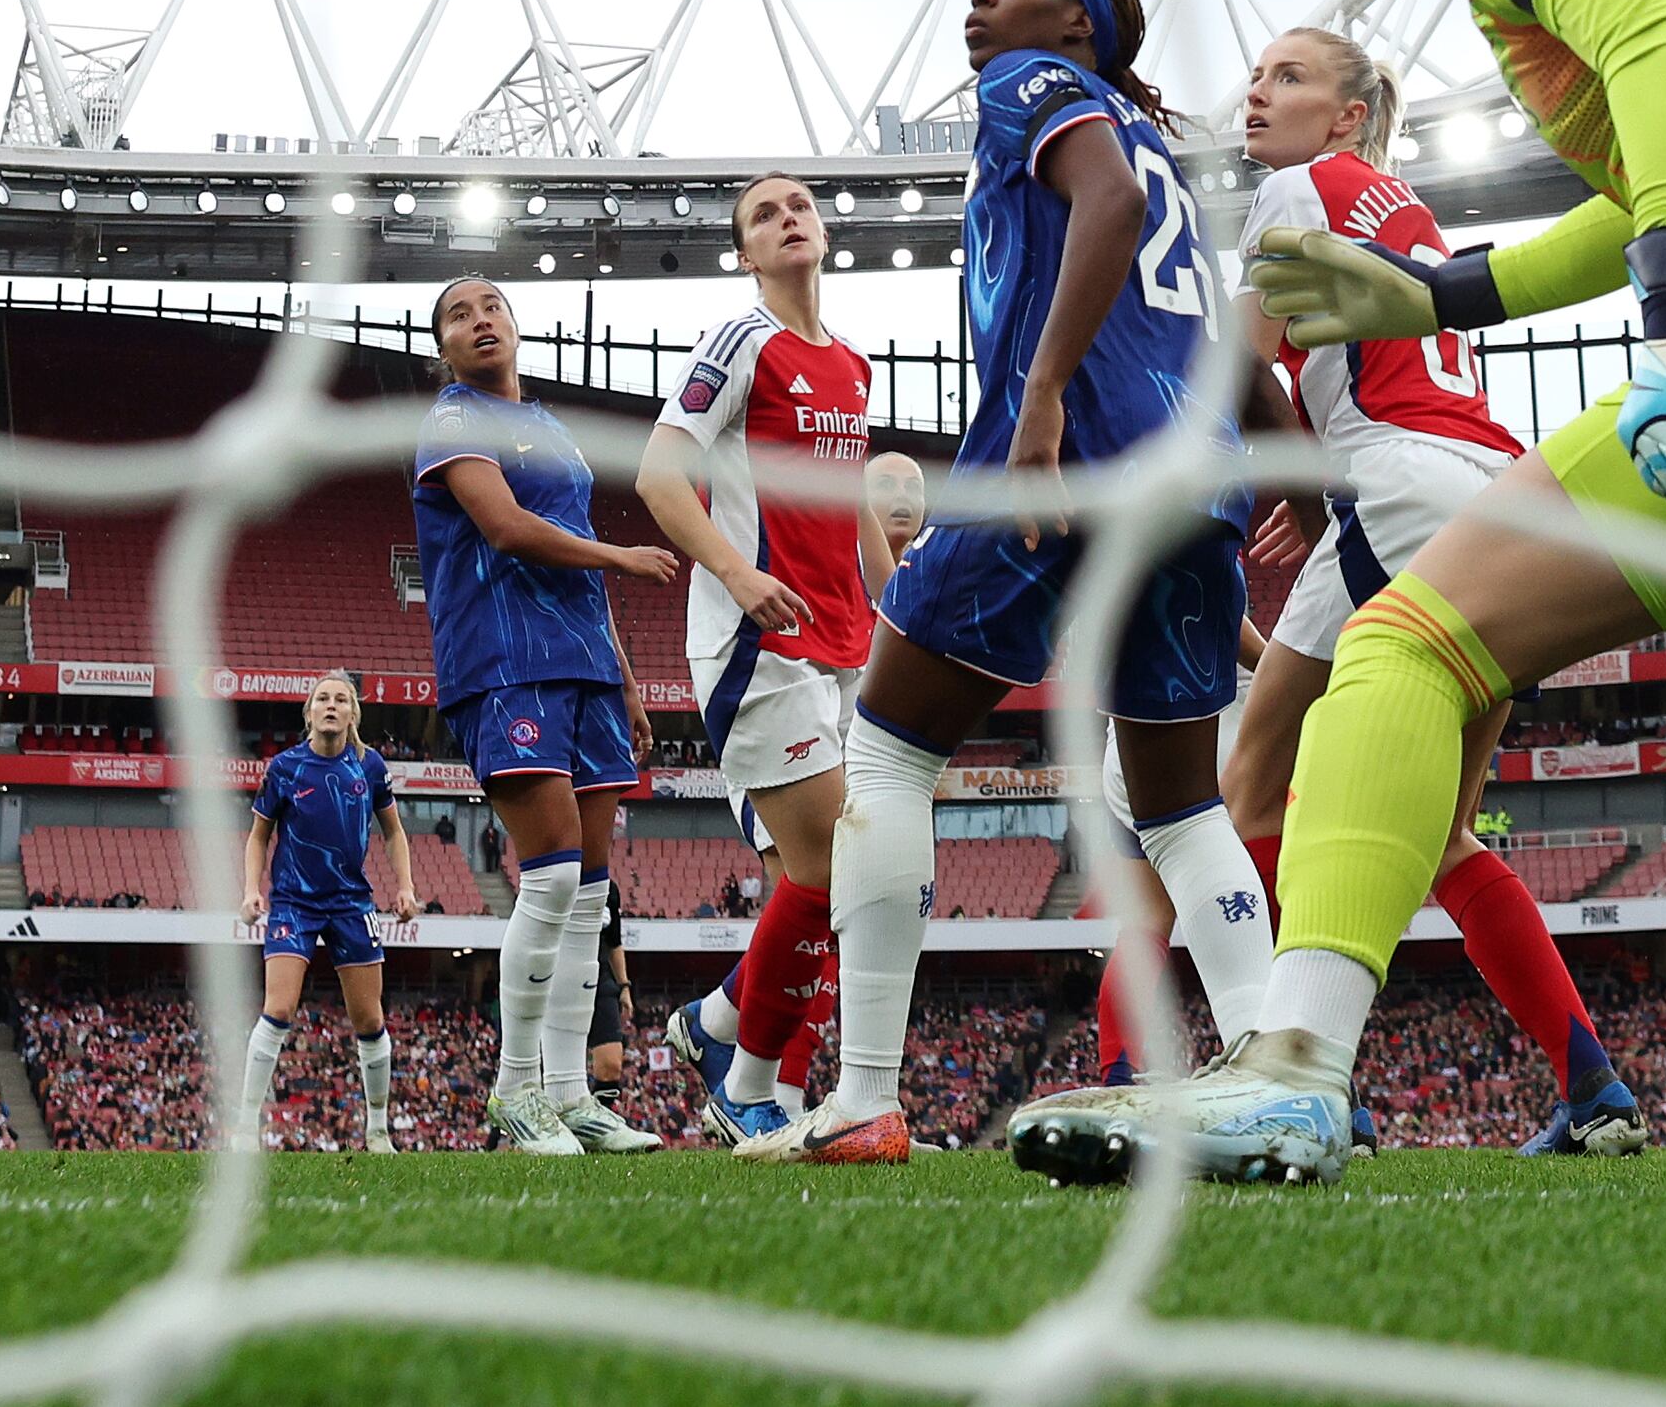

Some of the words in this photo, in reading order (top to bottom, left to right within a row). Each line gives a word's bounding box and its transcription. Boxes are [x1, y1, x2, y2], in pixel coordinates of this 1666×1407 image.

[1017, 68, 1079, 105] feve
[1344, 180, 1424, 239] WILLI
[795, 406, 869, 438] Emirat
[814, 437, 833, 458] FLY
[835, 438, 868, 461] BETT
[1568, 654, 1623, 671] SENAL
[77, 669, 152, 682] AZERBAIJAN
[242, 673, 318, 695] GAYGOONER
[403, 681, 431, 701] 19
[650, 683, 695, 702] 않습니
[222, 759, 270, 774] FOOTB
[423, 767, 472, 778] ARSEN
[682, 769, 721, 781] ARSEN
[675, 785, 728, 799] PARAGU
[980, 784, 1059, 796] Gunners
[380, 921, 418, 943] ETTER
